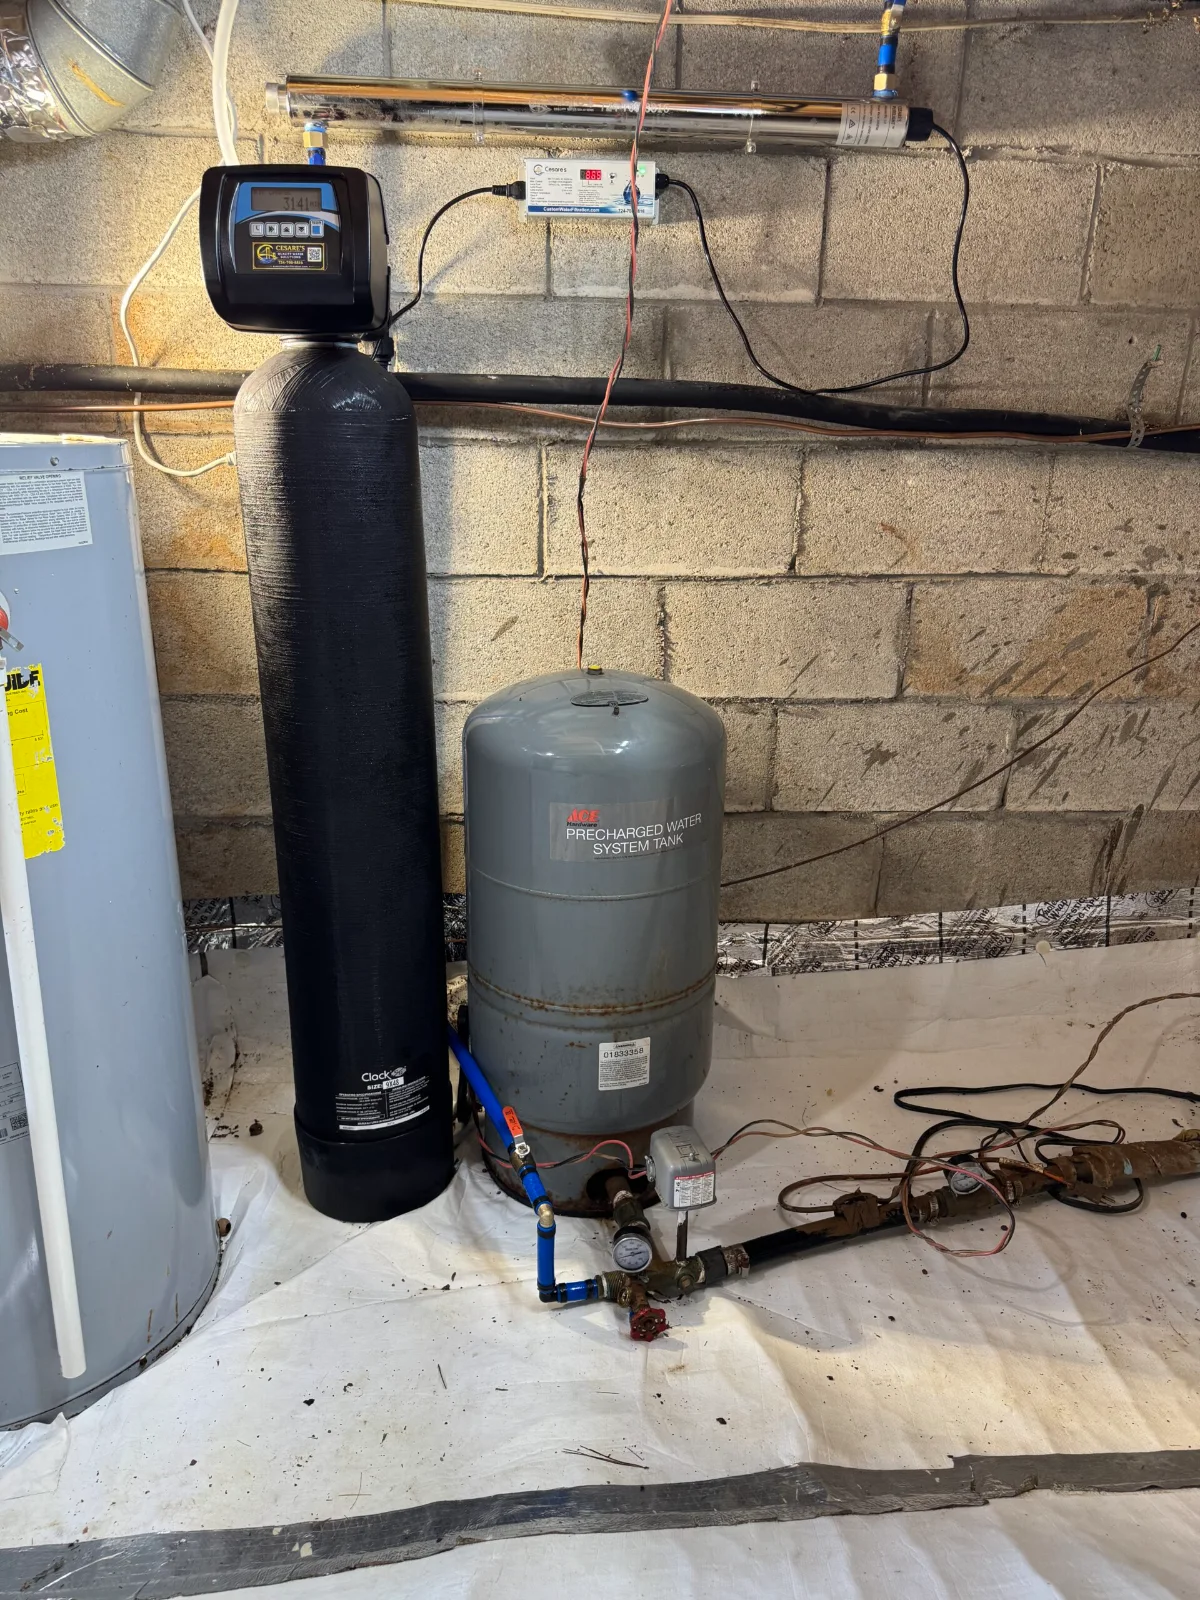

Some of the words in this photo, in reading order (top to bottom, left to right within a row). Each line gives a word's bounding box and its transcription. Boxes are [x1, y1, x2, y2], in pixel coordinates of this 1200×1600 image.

[566, 808, 600, 822] ACE
[566, 824, 664, 840] PRECHARGED
[666, 812, 702, 833] WATER
[593, 839, 650, 855] SYSTEM
[652, 832, 684, 850] TANK
[1053, 914, 1071, 936] SUPER
[603, 1047, 644, 1059] 01833358
[361, 1070, 391, 1082] Clack
